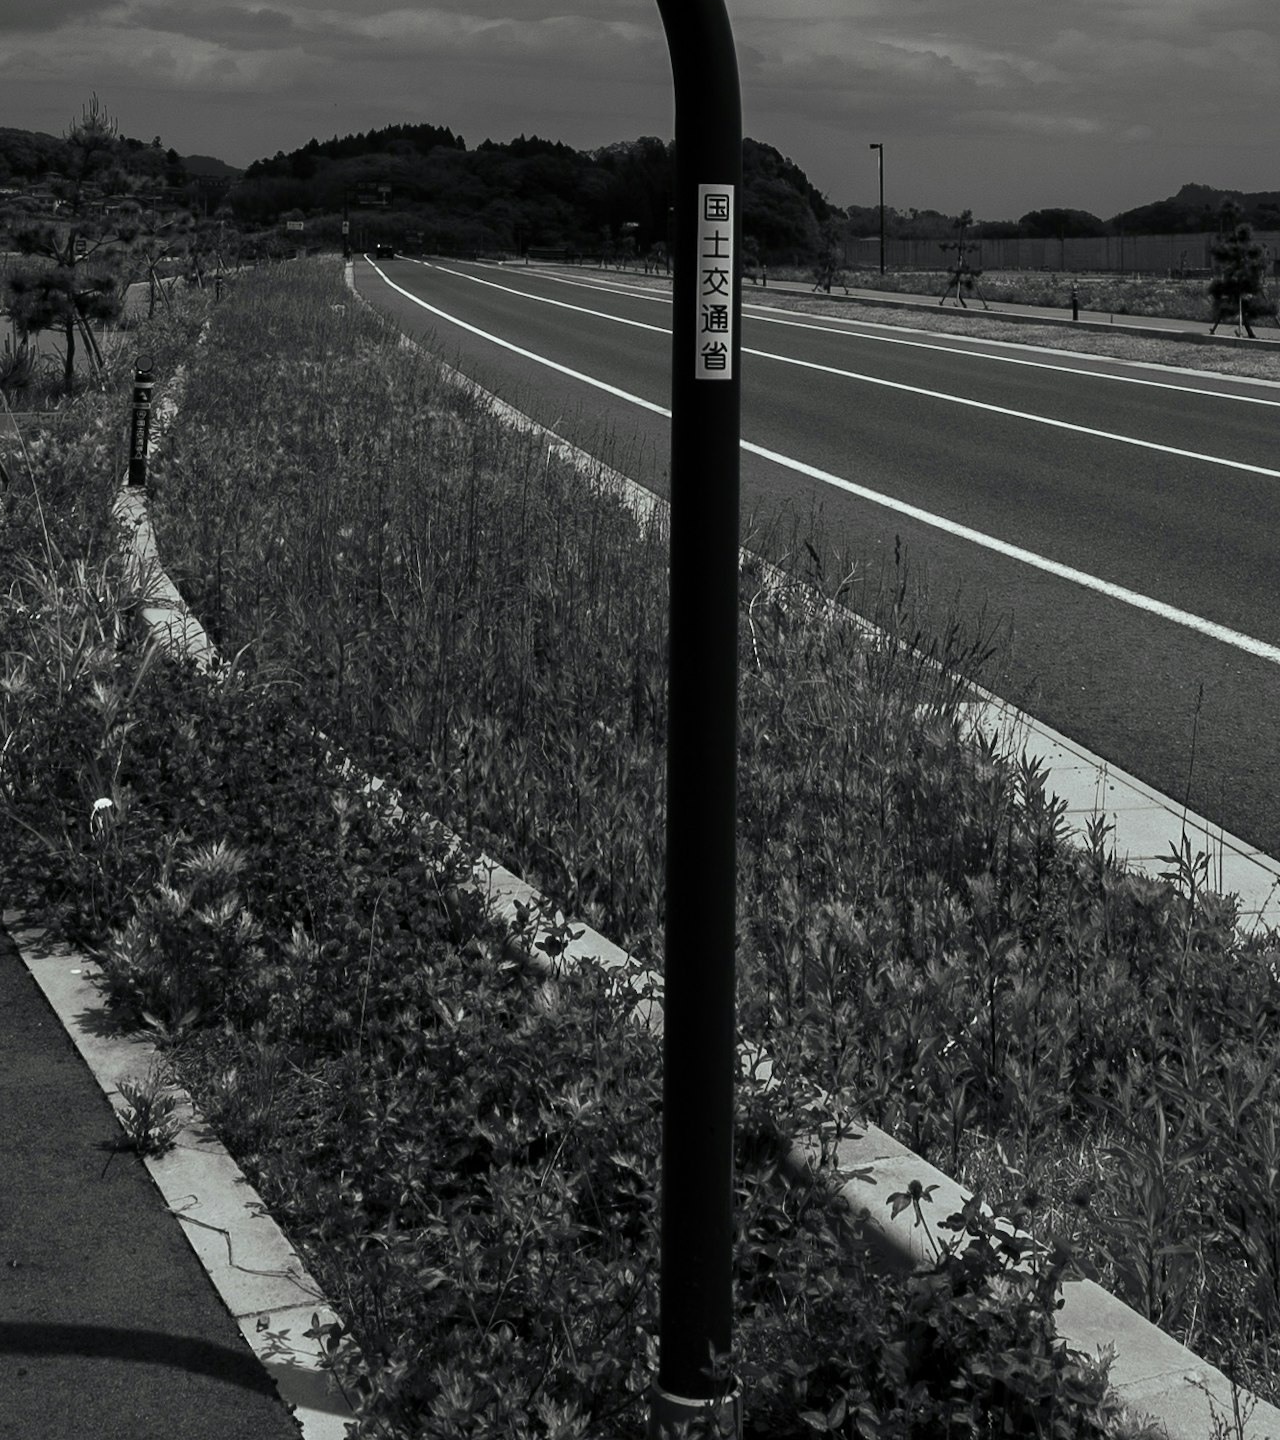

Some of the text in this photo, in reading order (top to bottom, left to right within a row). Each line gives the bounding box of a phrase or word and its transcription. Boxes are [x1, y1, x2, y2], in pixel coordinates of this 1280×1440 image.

[701, 194, 729, 370] 国土交通省
